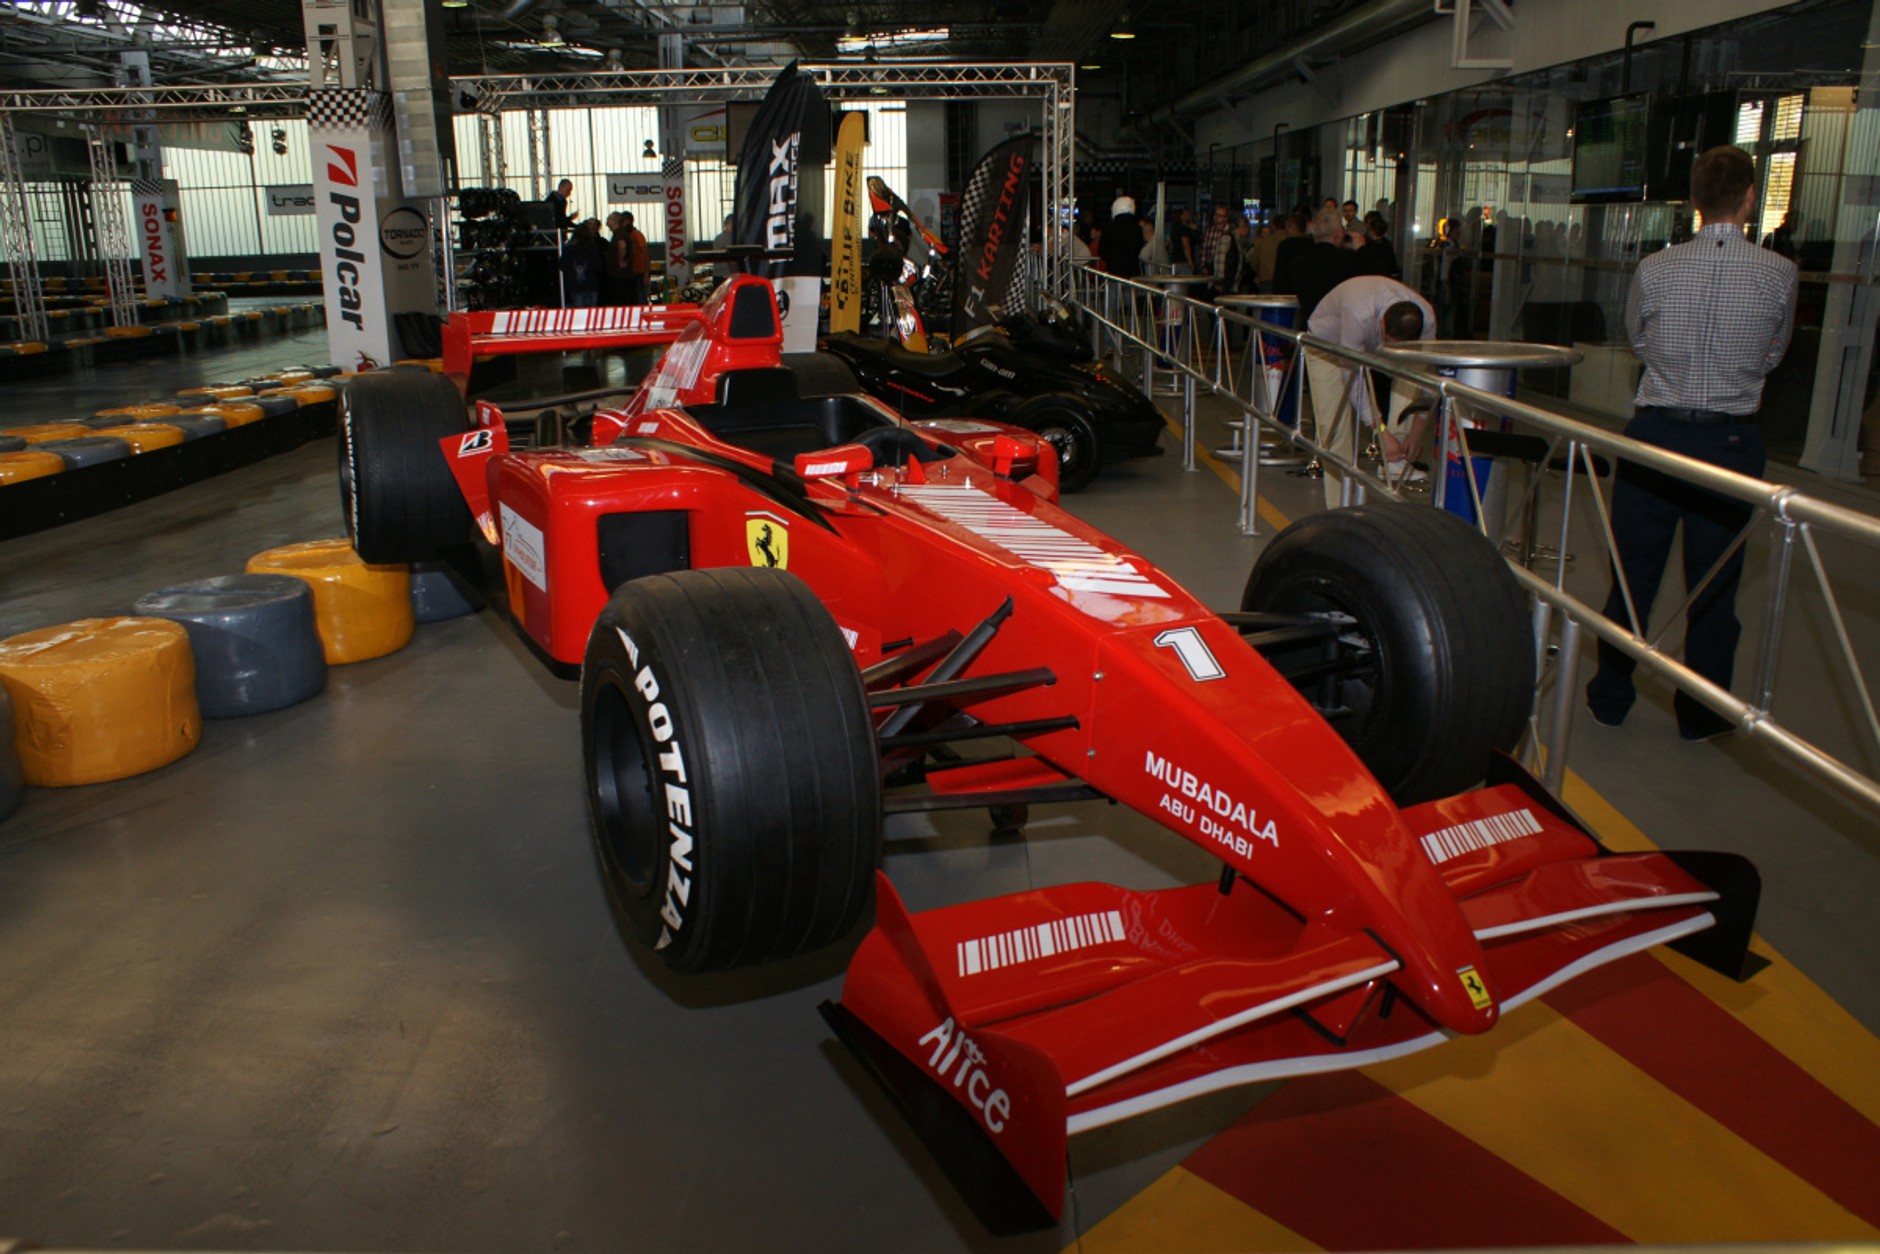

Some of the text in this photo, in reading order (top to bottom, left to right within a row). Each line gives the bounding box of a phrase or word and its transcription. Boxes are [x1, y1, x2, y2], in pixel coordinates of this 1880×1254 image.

[613, 182, 664, 196] trac
[842, 151, 855, 216] BIKE
[142, 203, 168, 282] SONAX
[329, 191, 366, 332] Polcar
[384, 228, 425, 240] TORNADO
[666, 186, 687, 267] SONAX
[964, 284, 985, 319] F1
[976, 152, 1026, 281] KARTING
[1153, 626, 1227, 682] 1
[634, 664, 695, 932] POTENZA
[1144, 750, 1280, 848] MUBADALA
[1159, 793, 1254, 861] ABU DHABI
[917, 1015, 1011, 1134] Alice
